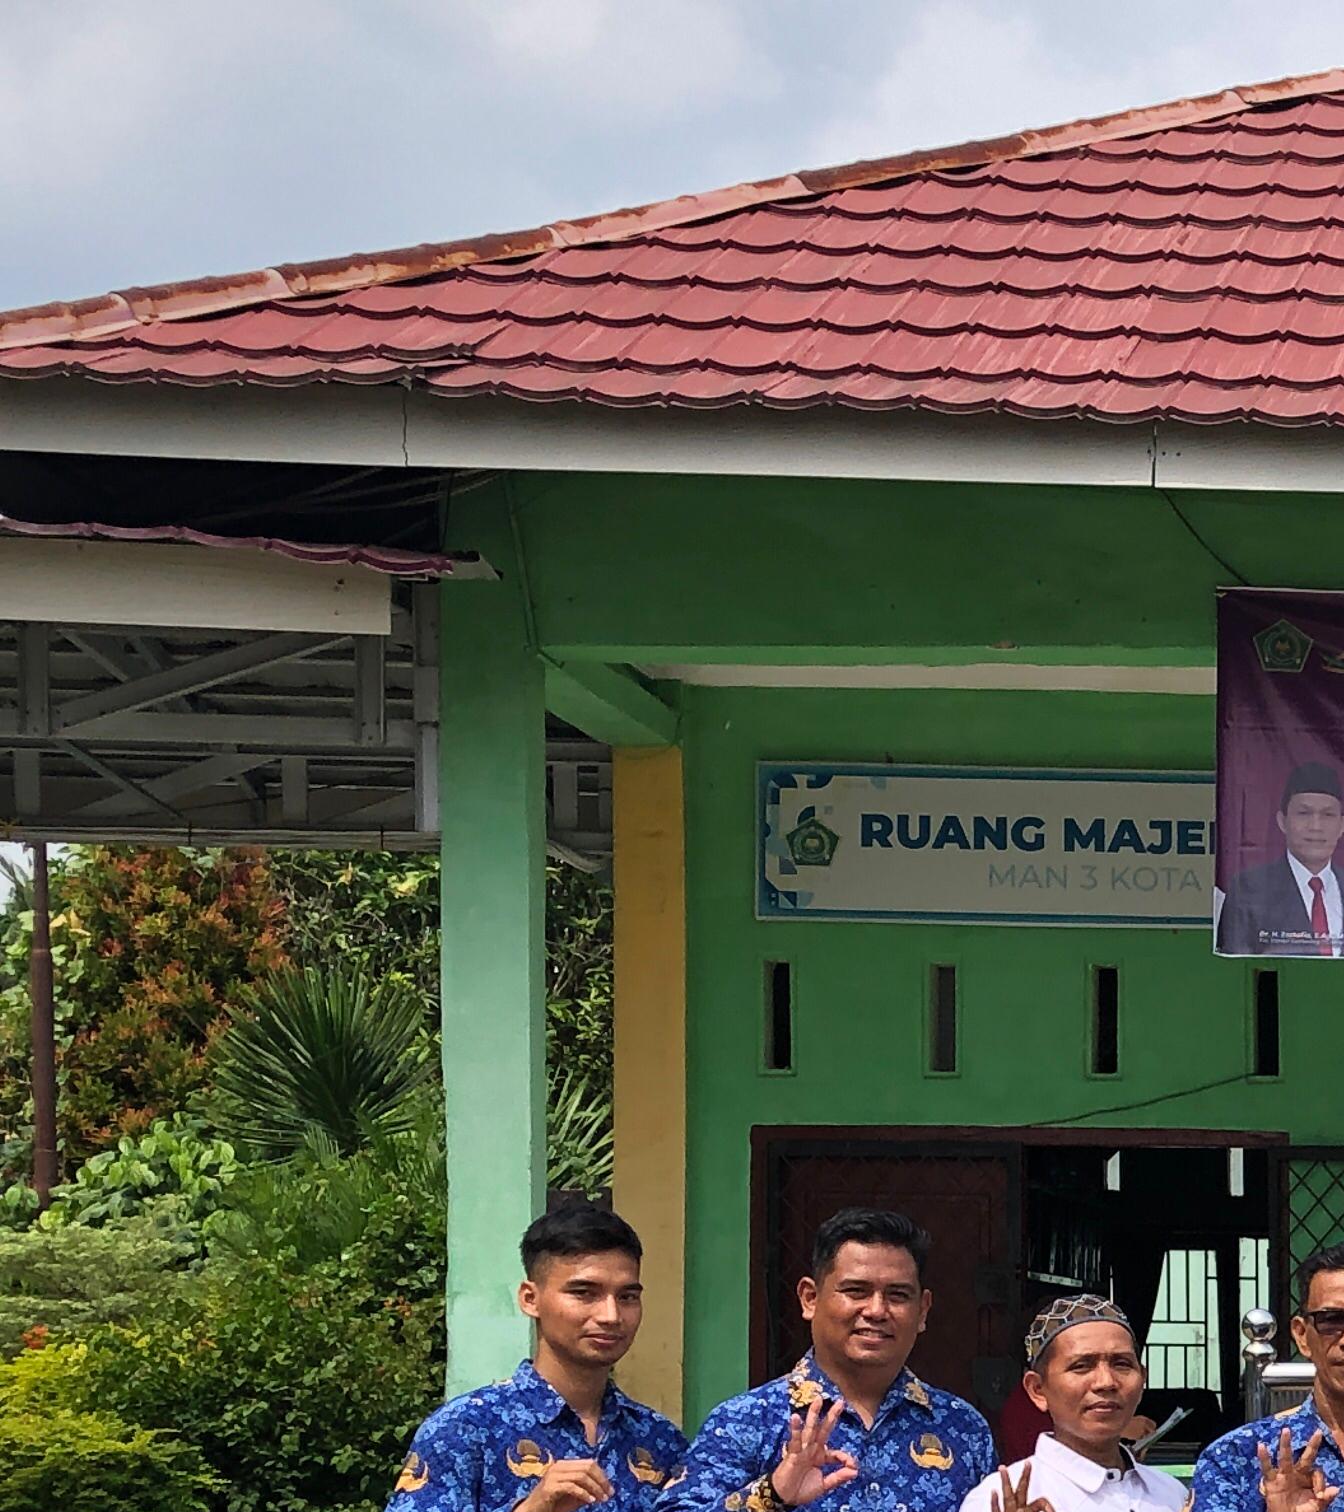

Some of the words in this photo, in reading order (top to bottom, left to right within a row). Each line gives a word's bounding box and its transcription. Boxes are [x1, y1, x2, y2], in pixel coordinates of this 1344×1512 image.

[860, 813, 1046, 852] RUANG
[988, 864, 1068, 889] MAN
[1080, 865, 1098, 890] 3
[1111, 866, 1202, 892] KOTA
